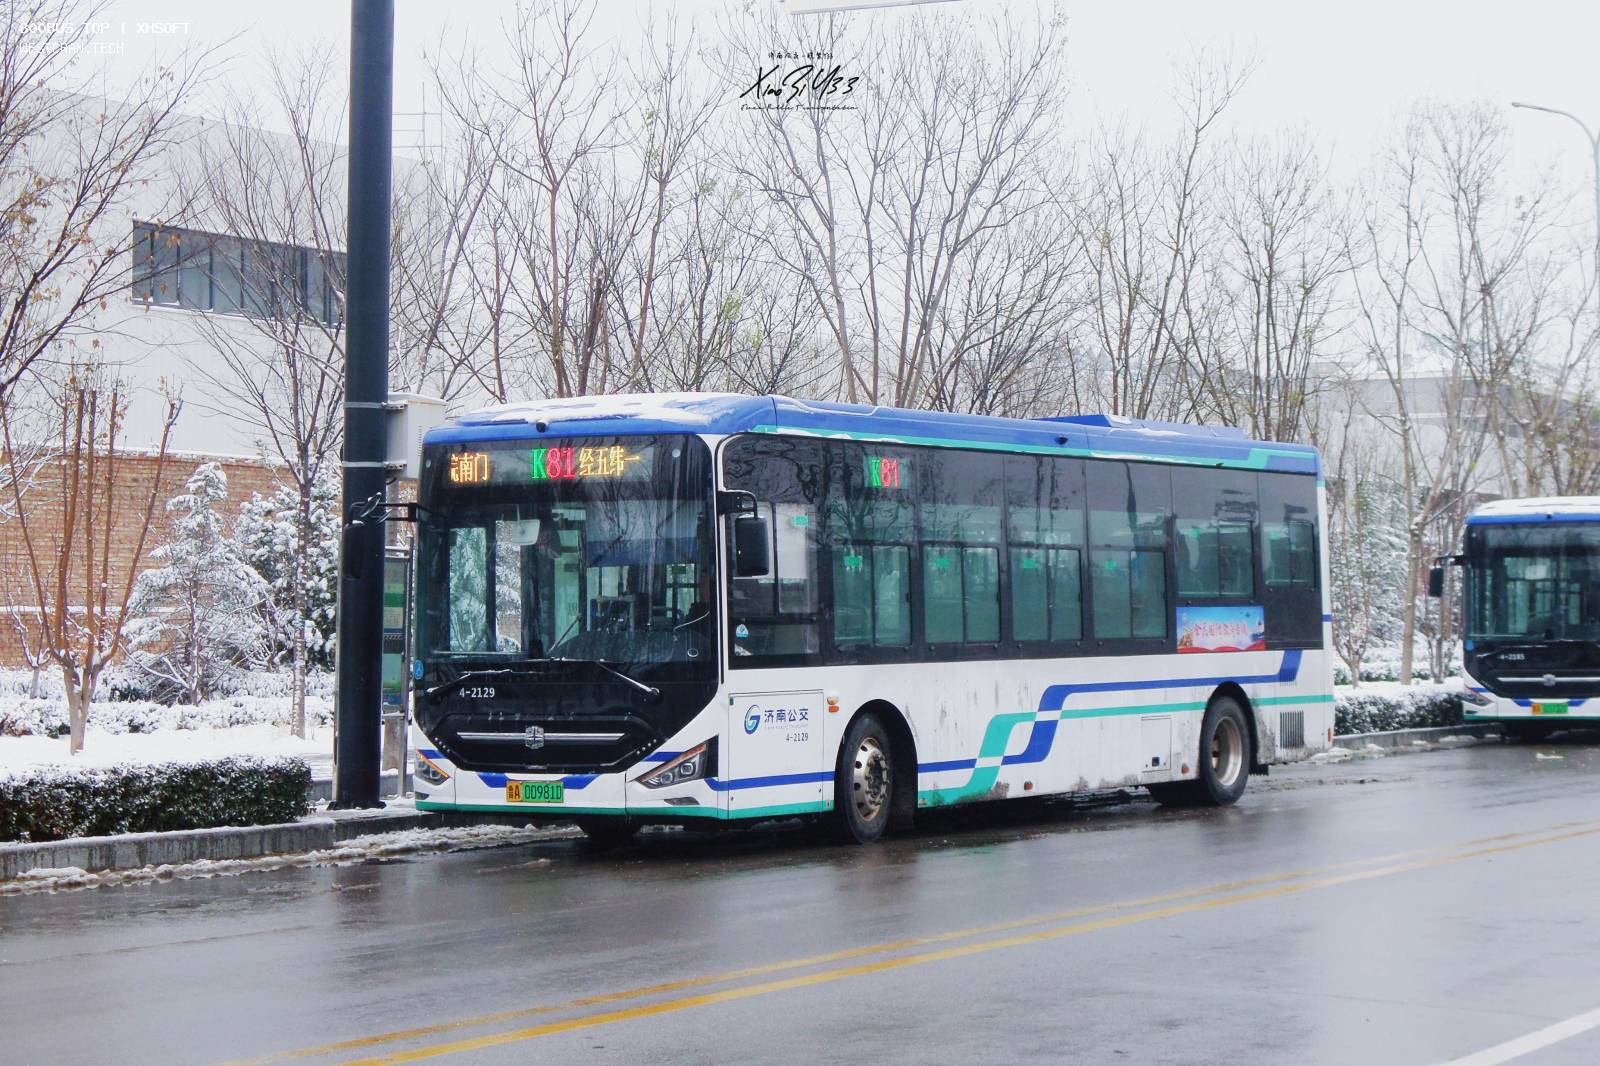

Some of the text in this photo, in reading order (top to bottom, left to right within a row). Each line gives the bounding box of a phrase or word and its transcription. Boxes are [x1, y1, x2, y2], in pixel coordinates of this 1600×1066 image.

[532, 447, 576, 480] K81
[579, 445, 640, 477] 经五纬一
[871, 458, 899, 488] K81
[459, 687, 495, 698] 4-2129
[764, 708, 809, 723] 济南公交
[786, 732, 809, 742] 4-2129
